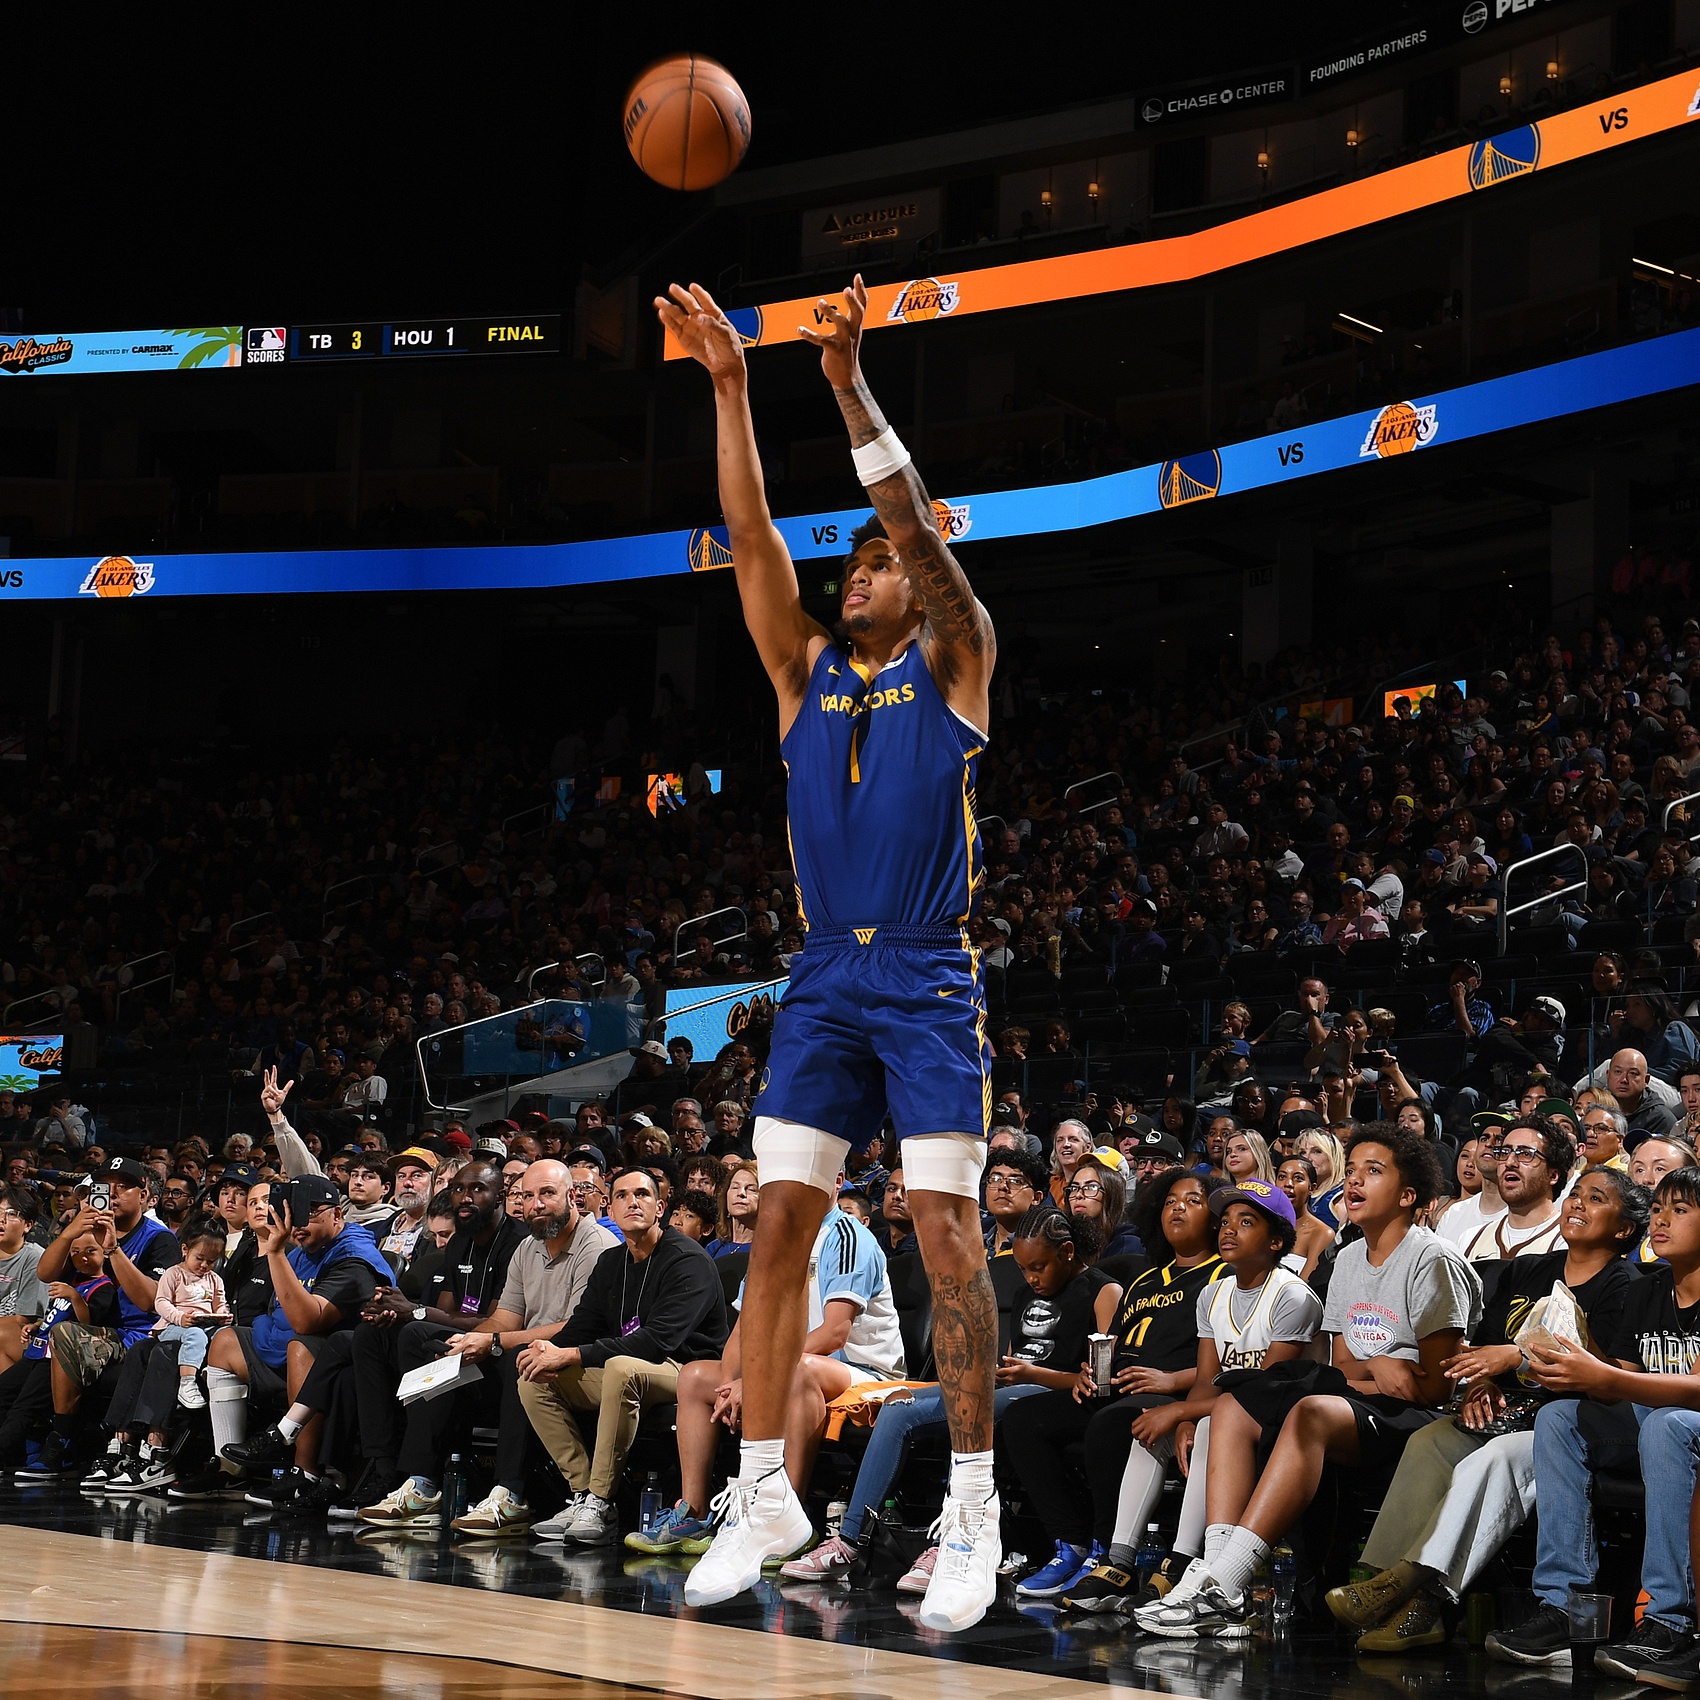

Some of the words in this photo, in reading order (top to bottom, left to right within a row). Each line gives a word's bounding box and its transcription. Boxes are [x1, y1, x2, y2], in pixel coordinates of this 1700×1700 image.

[1310, 53, 1365, 82] FOUNDING
[1368, 30, 1427, 61] PARTNERS
[1168, 93, 1217, 112] CHASE
[1236, 80, 1285, 99] CENTER
[1599, 107, 1628, 134] VS
[843, 204, 916, 227] ACRISURE
[924, 285, 955, 294] ANGELES
[894, 291, 954, 317] LAKERS
[309, 334, 332, 349] TB
[352, 331, 362, 349] 3
[394, 330, 433, 346] HOU
[446, 327, 454, 346] 1
[488, 325, 544, 342] FINAL
[28, 353, 66, 366] CLASSIC
[87, 348, 120, 356] PRESENTED
[247, 350, 285, 363] SCORES
[1386, 416, 1398, 424] LOS
[1399, 408, 1433, 422] ANGELES
[1367, 417, 1431, 452] LAKERS
[1277, 443, 1304, 466] VS
[812, 525, 838, 545] VS
[937, 515, 966, 536] ERS
[0, 570, 23, 588] VS
[85, 567, 150, 591] LAKERS
[820, 683, 915, 716] WARORS
[110, 1157, 123, 1170] B
[1121, 1304, 1134, 1326] AN
[1136, 1290, 1184, 1312] FRANCISCO
[1362, 1332, 1387, 1341] VEGAS
[1220, 1341, 1268, 1369] LAER
[1104, 1569, 1127, 1584] NIKE
